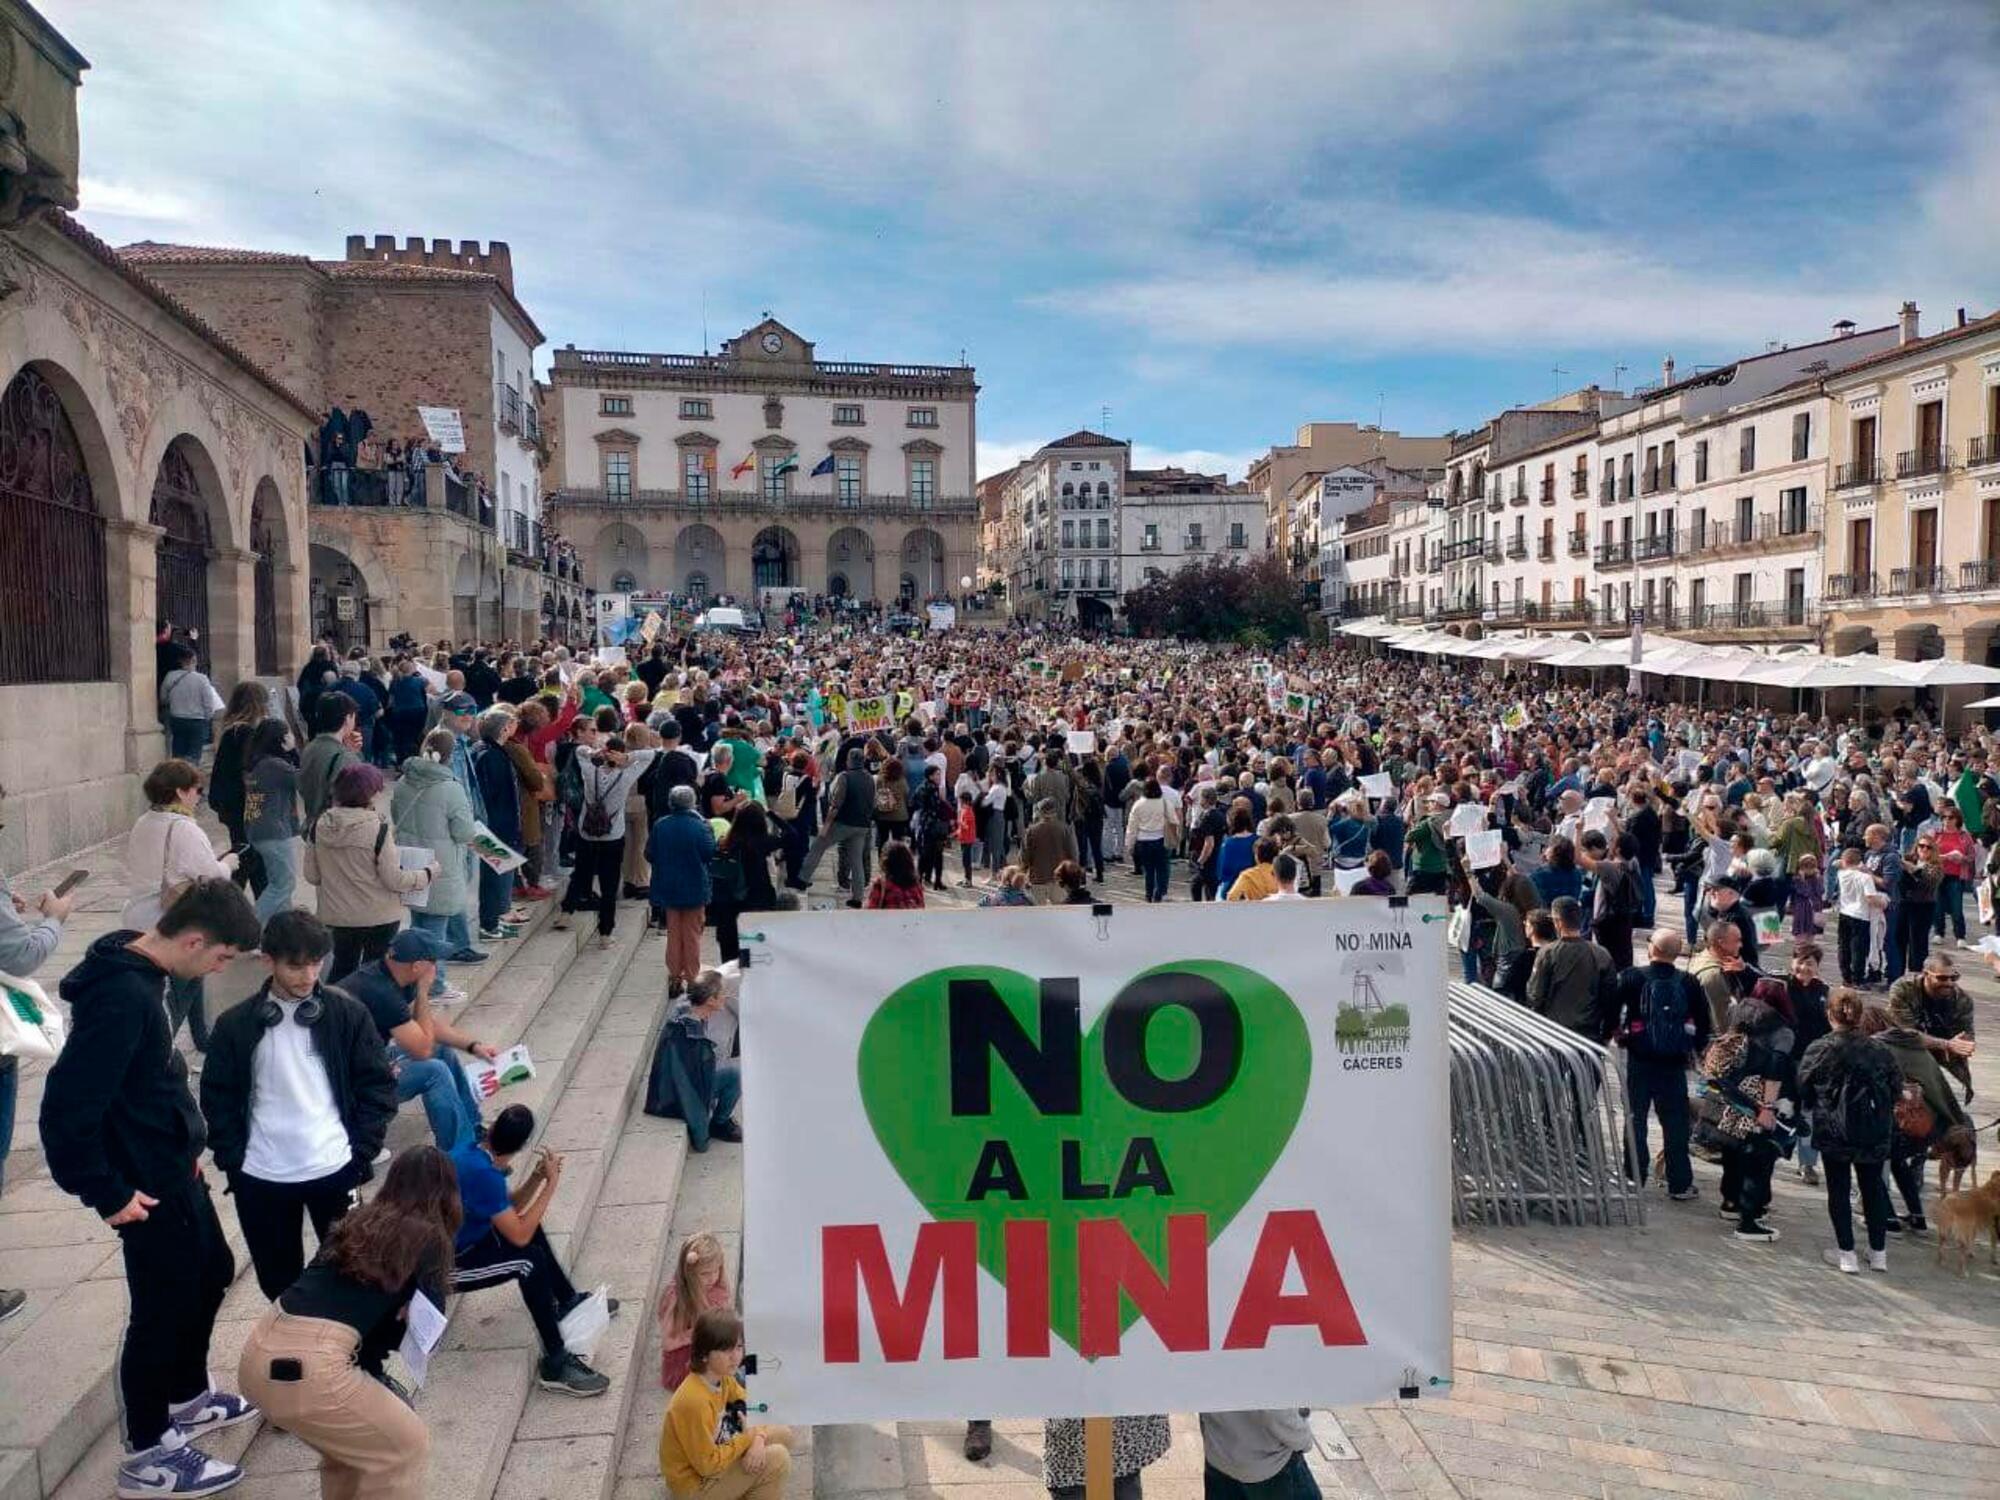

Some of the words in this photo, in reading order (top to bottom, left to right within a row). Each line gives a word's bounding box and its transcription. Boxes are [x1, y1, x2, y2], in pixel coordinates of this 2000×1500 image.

[858, 699, 880, 712] NO
[1335, 933, 1360, 951] NO
[1369, 931, 1413, 951] MINA
[948, 972, 1244, 1117] NO
[965, 1140, 1028, 1201] A
[1060, 1137, 1175, 1200] LA
[821, 1209, 1368, 1364] MINA
